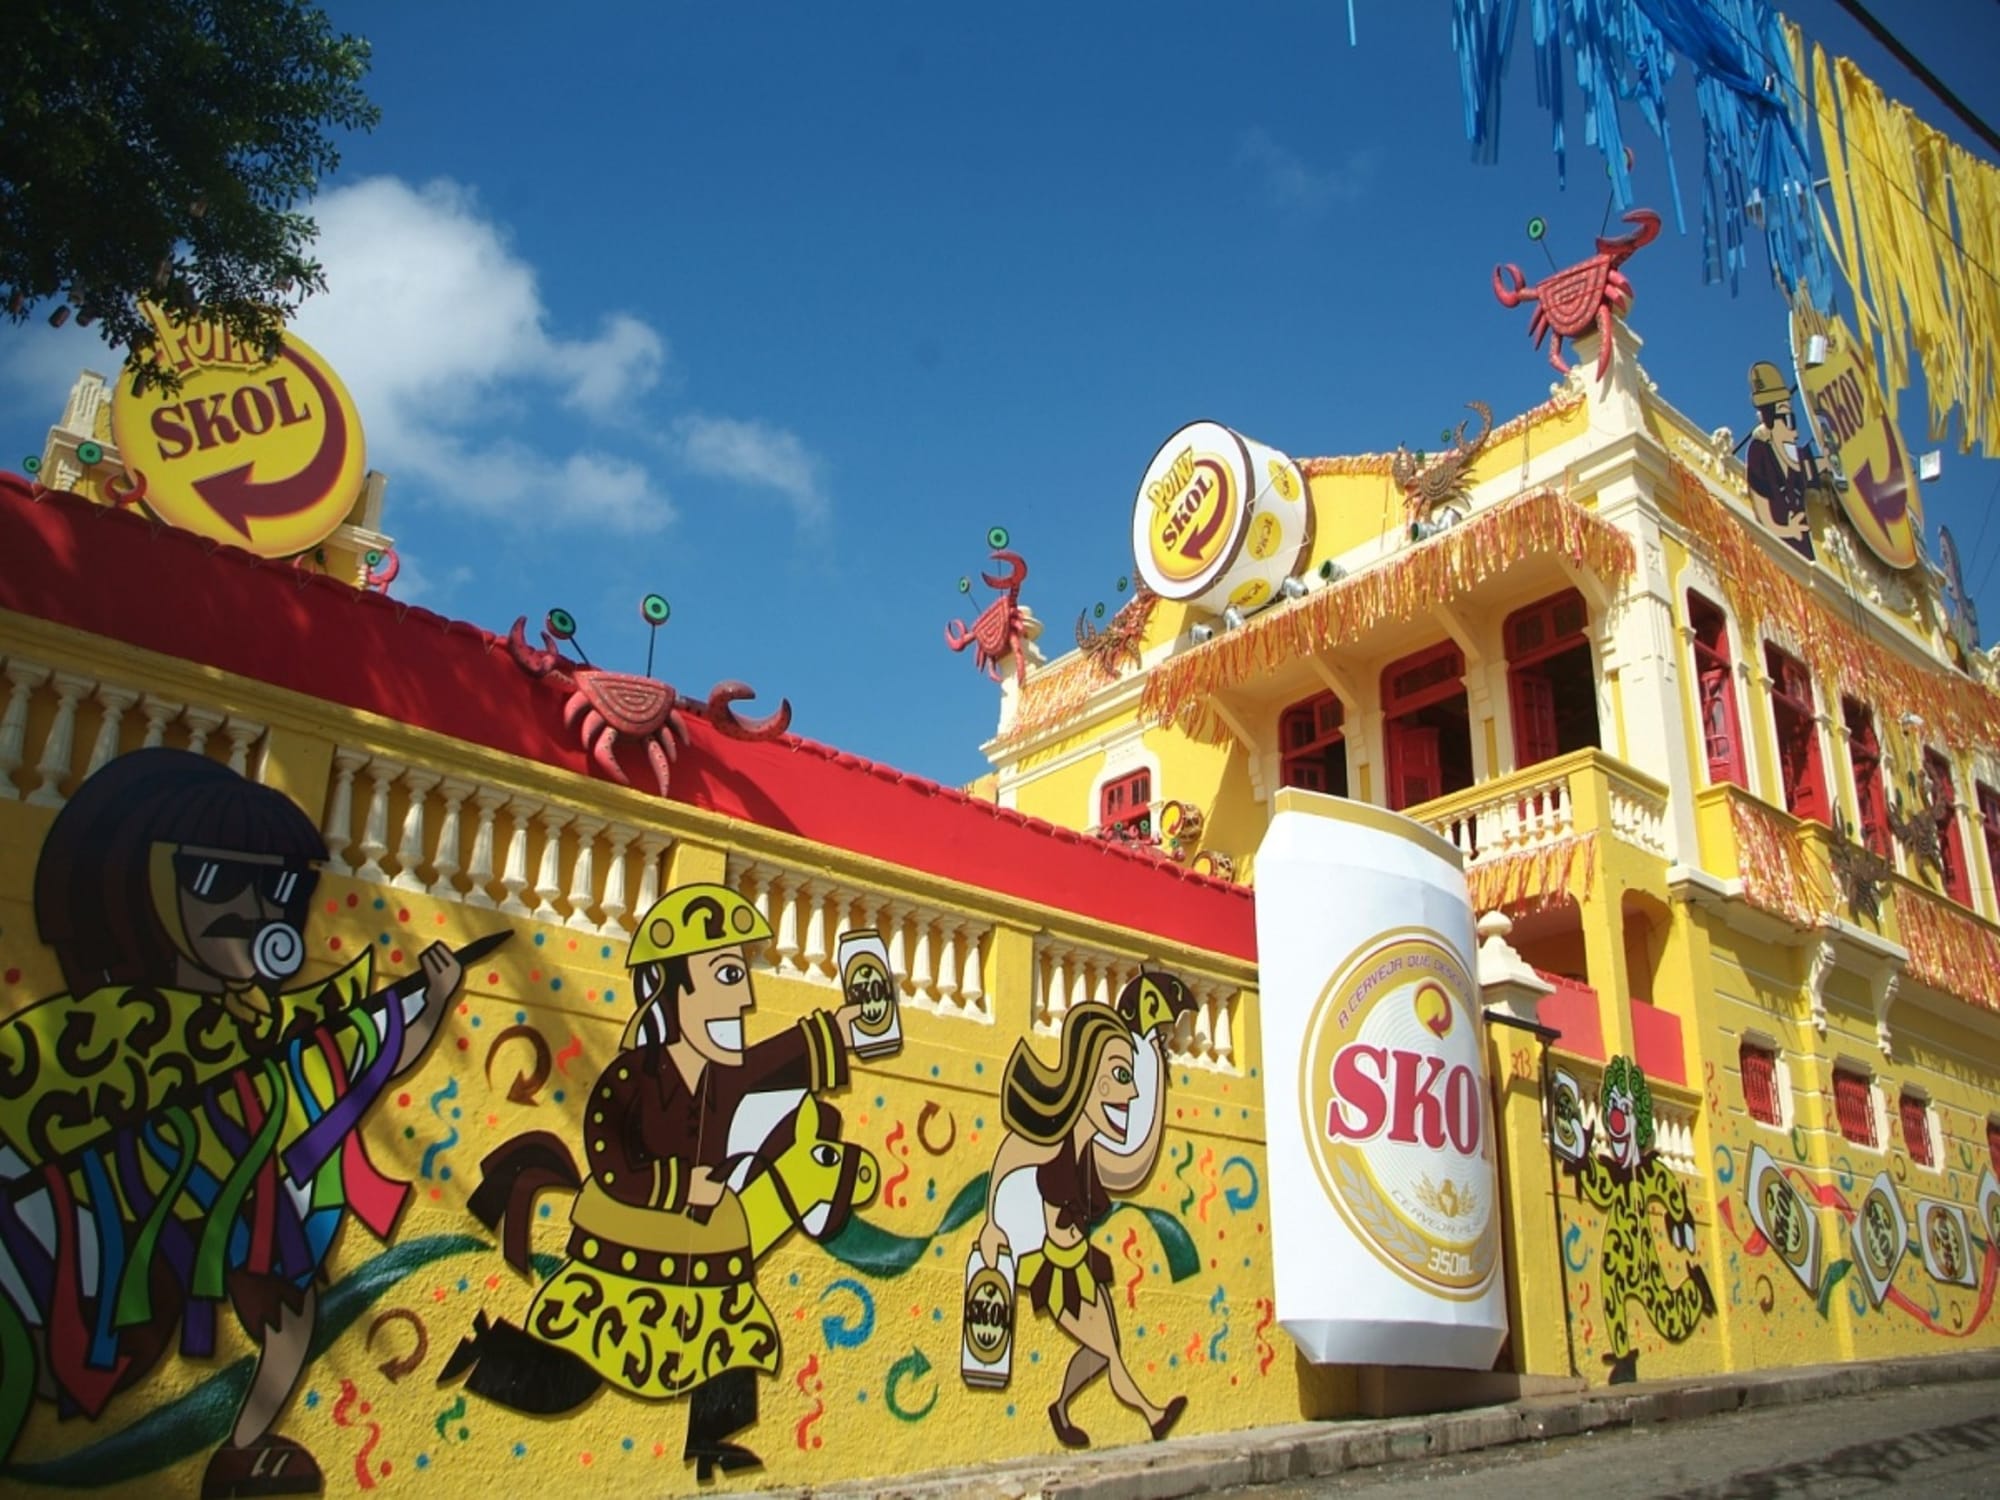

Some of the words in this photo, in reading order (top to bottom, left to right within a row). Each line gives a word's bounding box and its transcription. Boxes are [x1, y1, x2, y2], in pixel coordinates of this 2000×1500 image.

[151, 376, 312, 461] SKOL
[1147, 446, 1194, 513] POINT
[1162, 475, 1214, 552] SKOL
[1338, 1009, 1349, 1030] A
[1348, 957, 1402, 1012] CERVEJA
[1407, 955, 1431, 968] QUE
[1328, 1044, 1481, 1156] SKO
